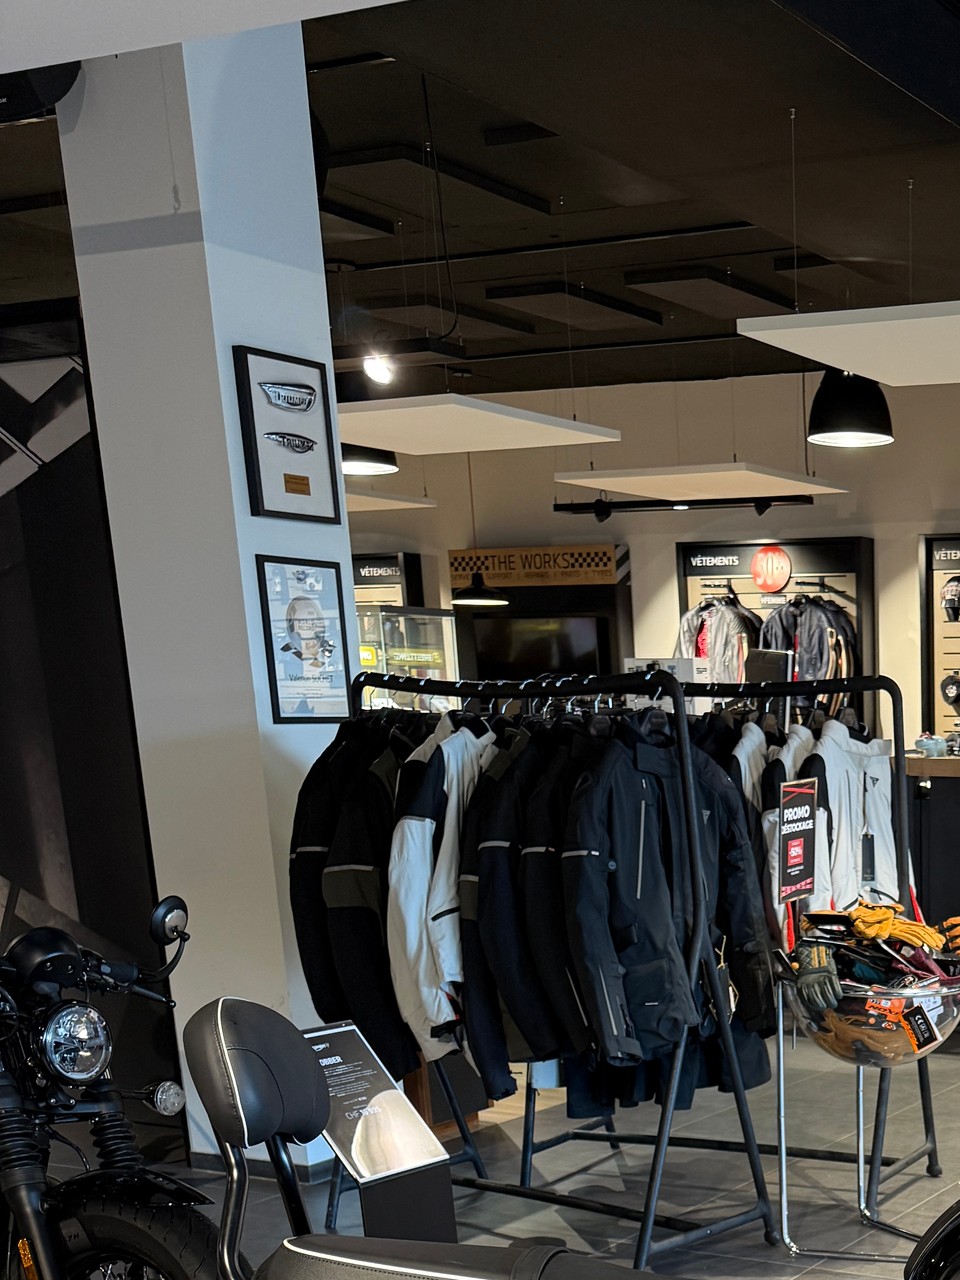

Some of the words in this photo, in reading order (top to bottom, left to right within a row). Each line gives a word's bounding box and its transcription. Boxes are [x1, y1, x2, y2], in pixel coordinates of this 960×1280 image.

[489, 555, 517, 571] THE
[519, 552, 571, 570] WORKS
[784, 805, 811, 821] PROMO
[319, 1056, 343, 1067] OBBER
